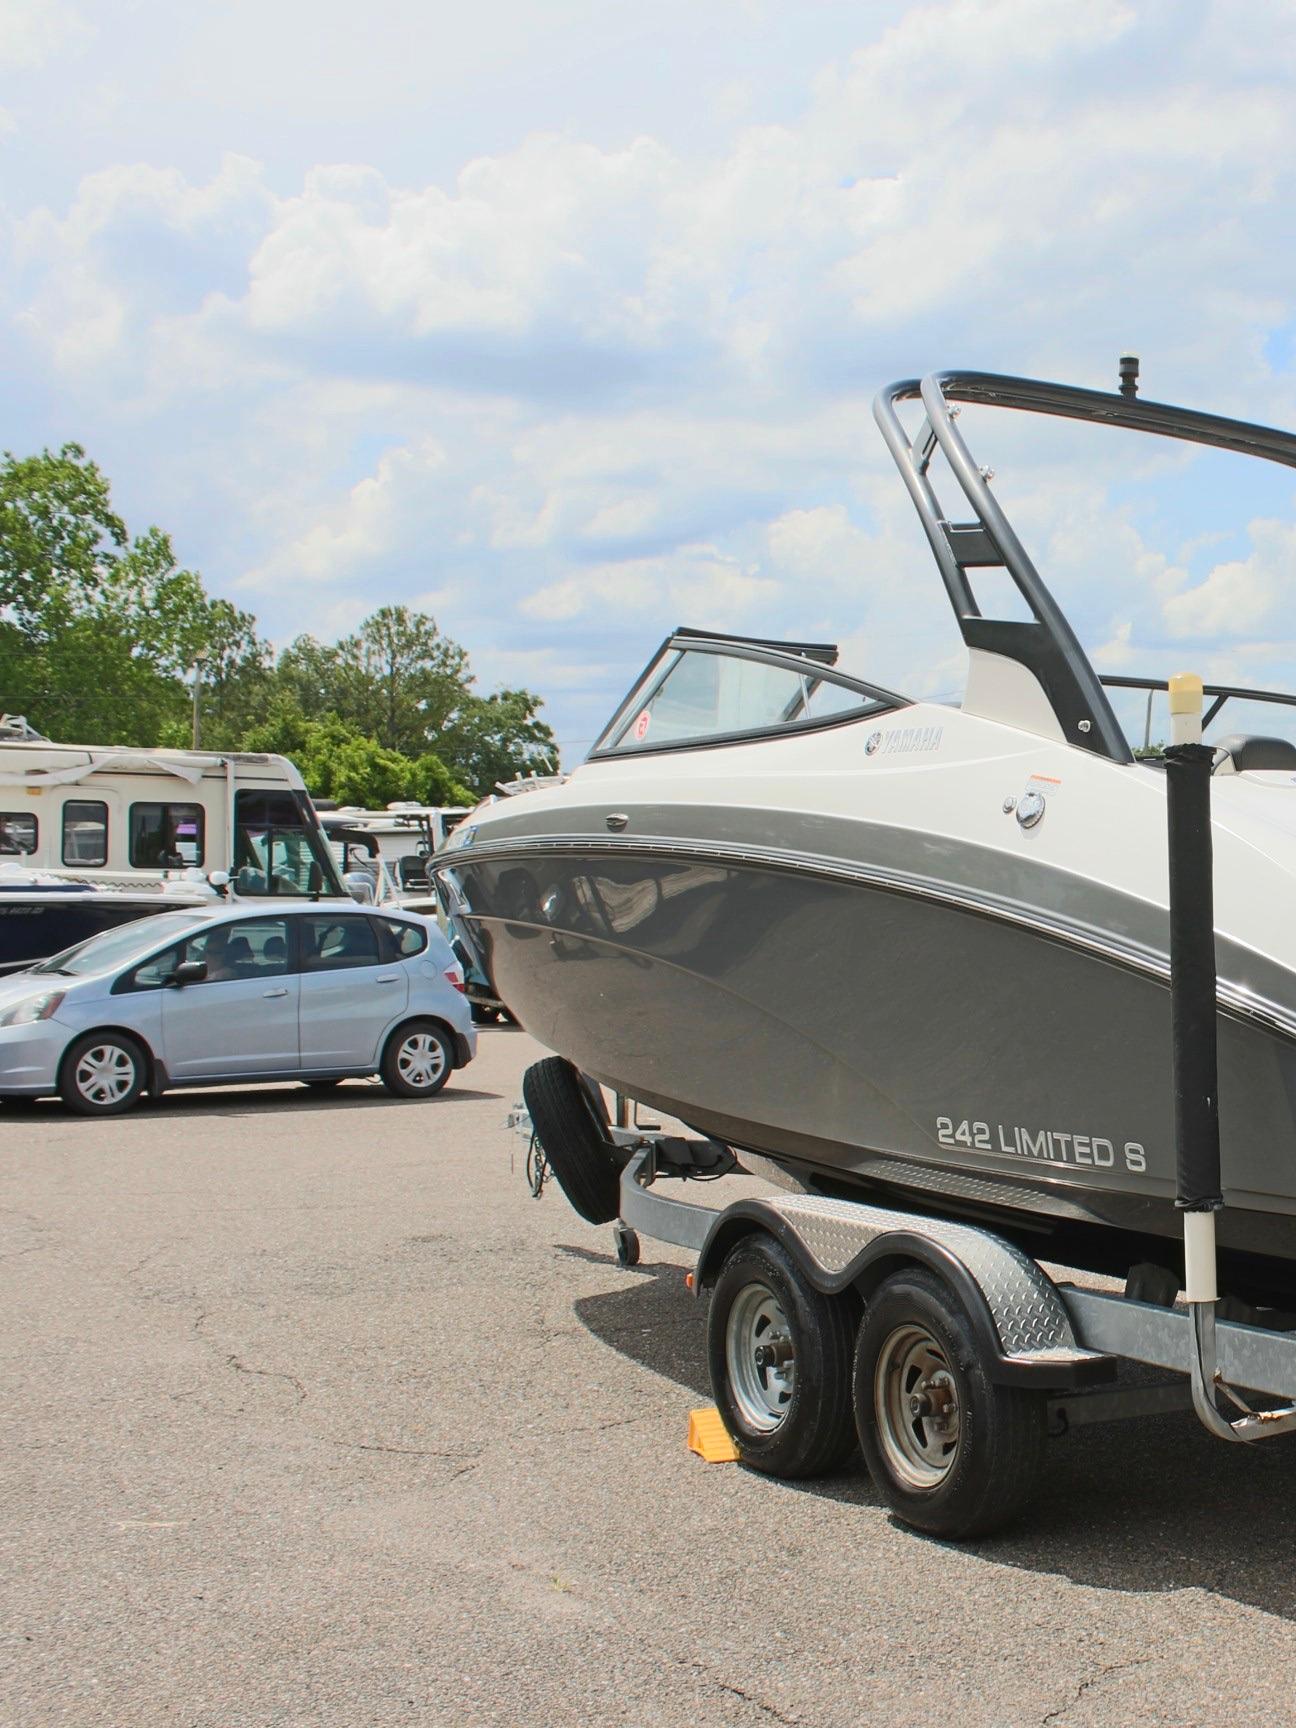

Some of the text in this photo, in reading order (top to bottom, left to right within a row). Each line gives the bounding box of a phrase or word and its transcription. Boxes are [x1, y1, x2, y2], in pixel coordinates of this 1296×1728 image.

[881, 727, 944, 754] YAMAHA
[936, 1116, 1146, 1172] 242 LIMITED S
